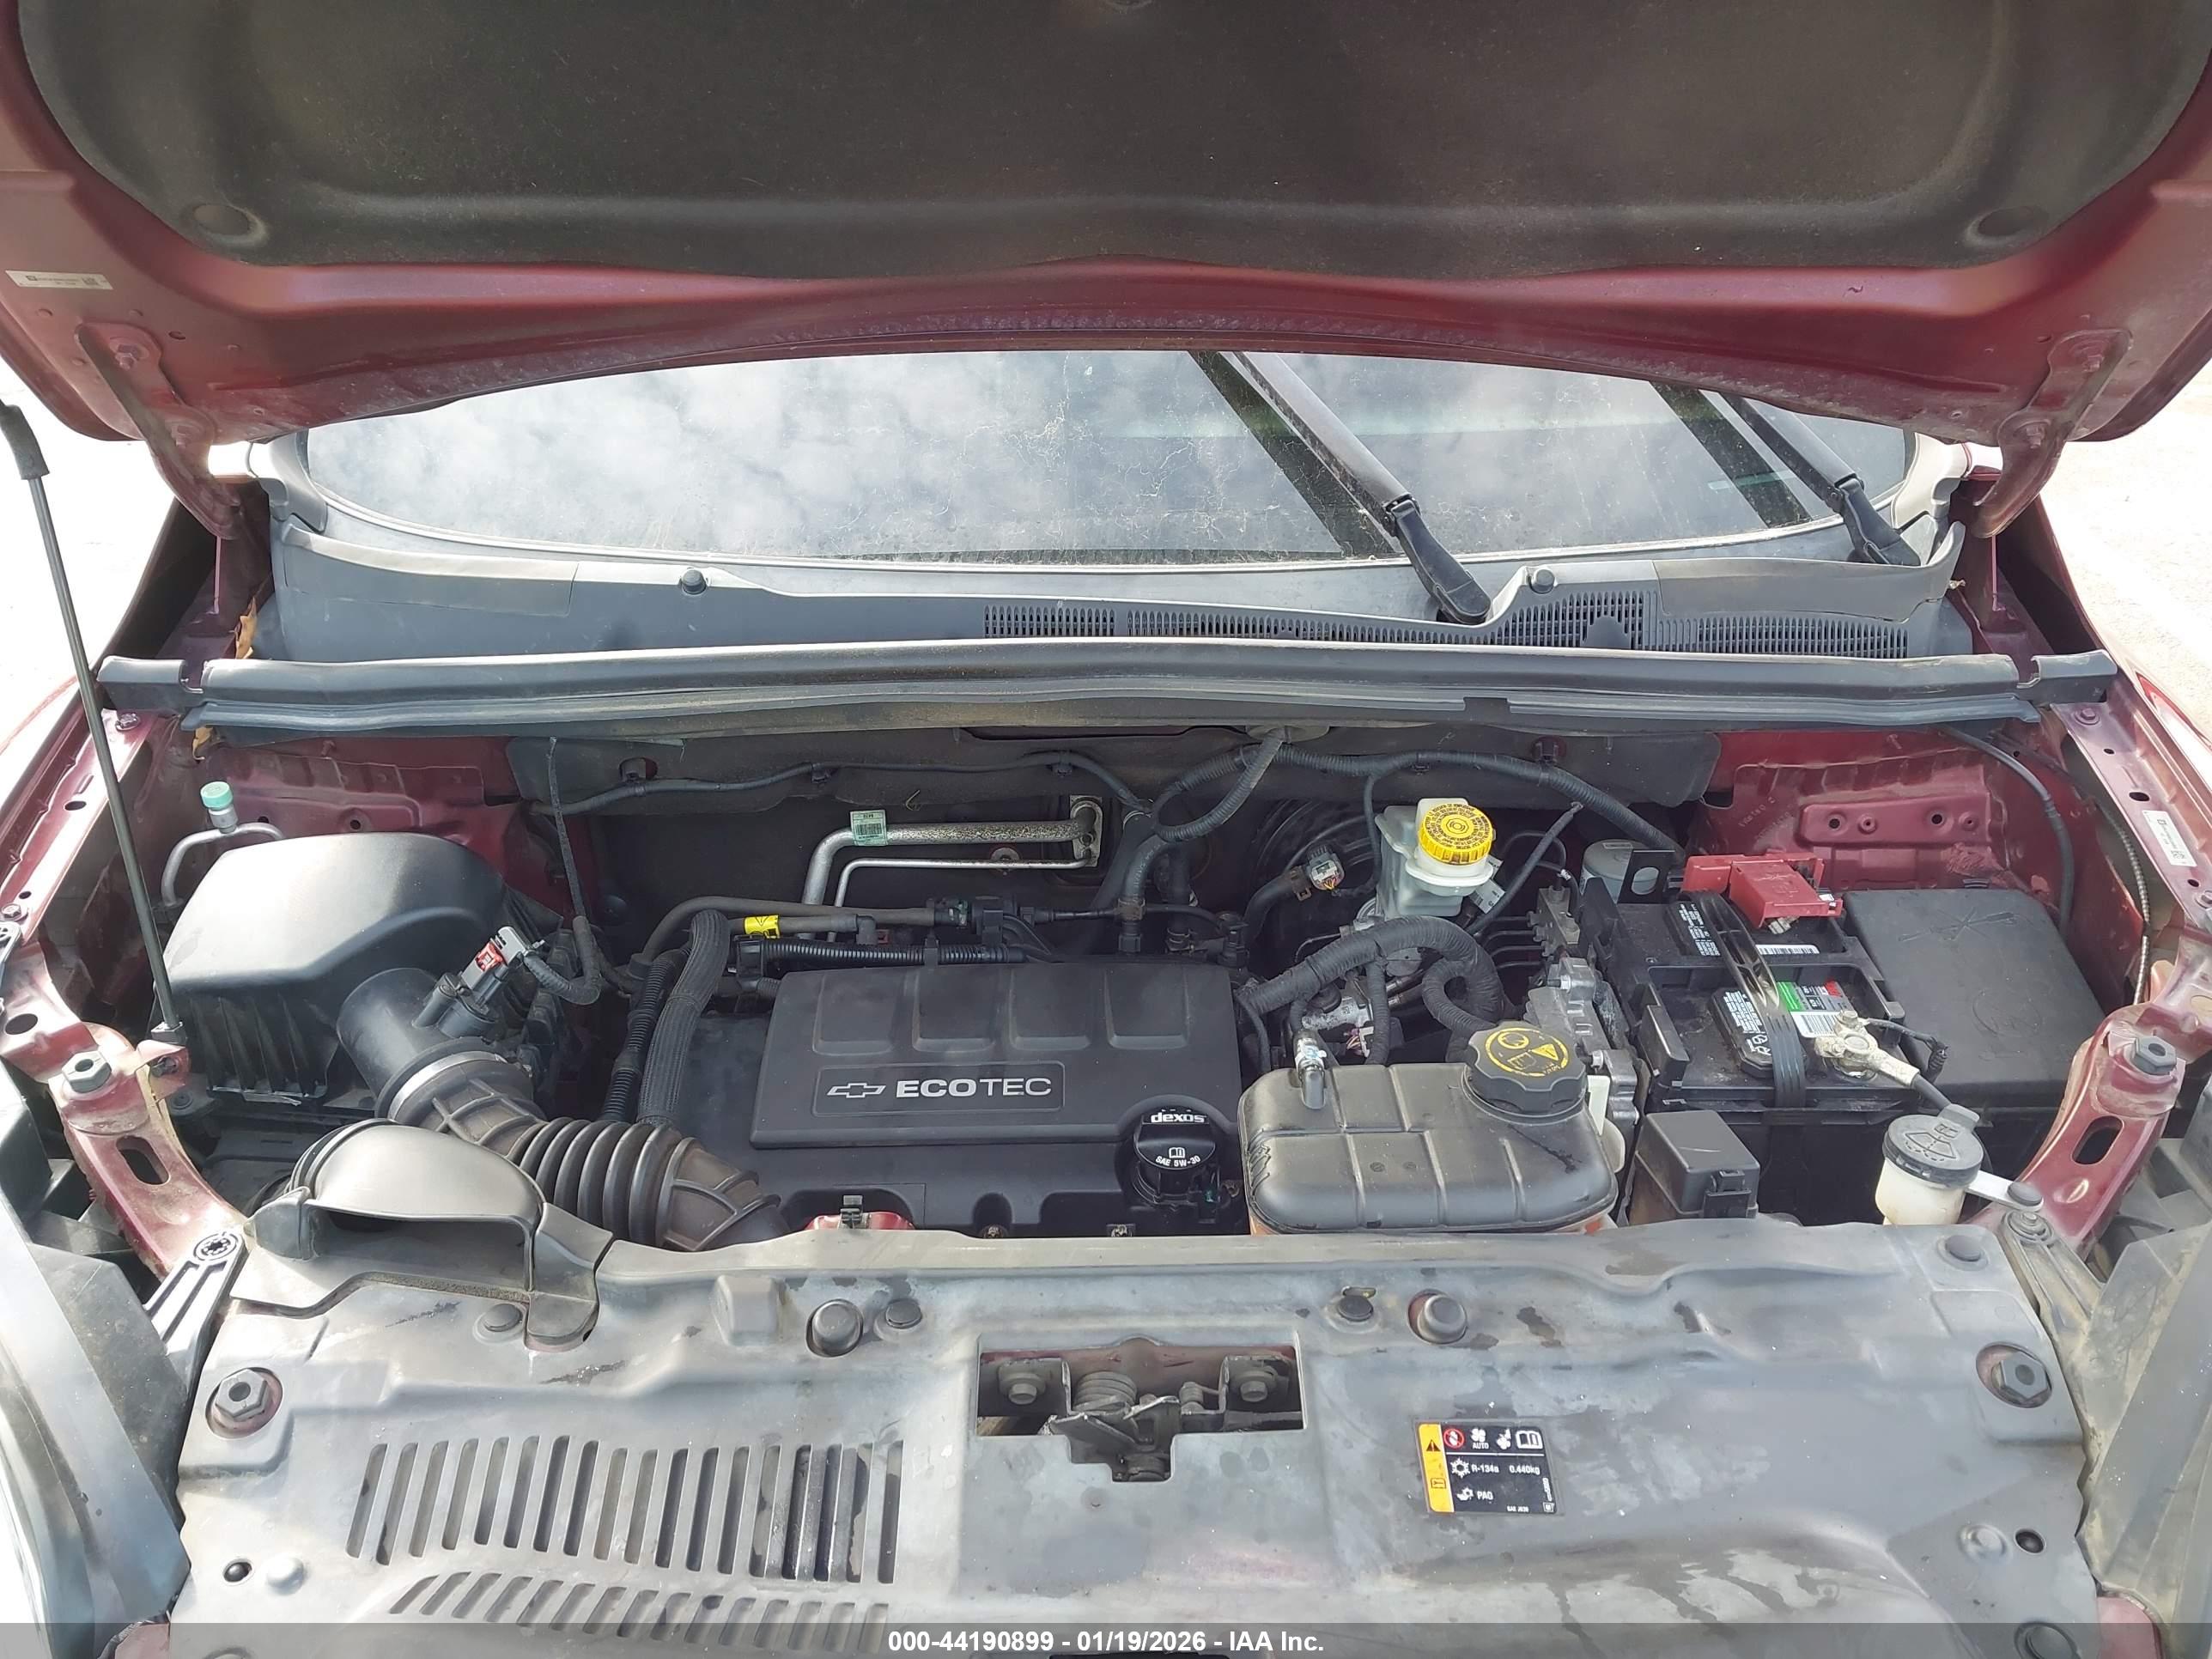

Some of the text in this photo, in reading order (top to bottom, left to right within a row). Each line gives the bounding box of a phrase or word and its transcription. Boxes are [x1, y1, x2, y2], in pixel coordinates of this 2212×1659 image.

[896, 1078, 1052, 1098] ECOTEC
[1151, 1112, 1205, 1123] dexos
[1155, 1155, 1201, 1167] SAE 5W-30
[1471, 1463, 1540, 1475] R-134a 0.440kg
